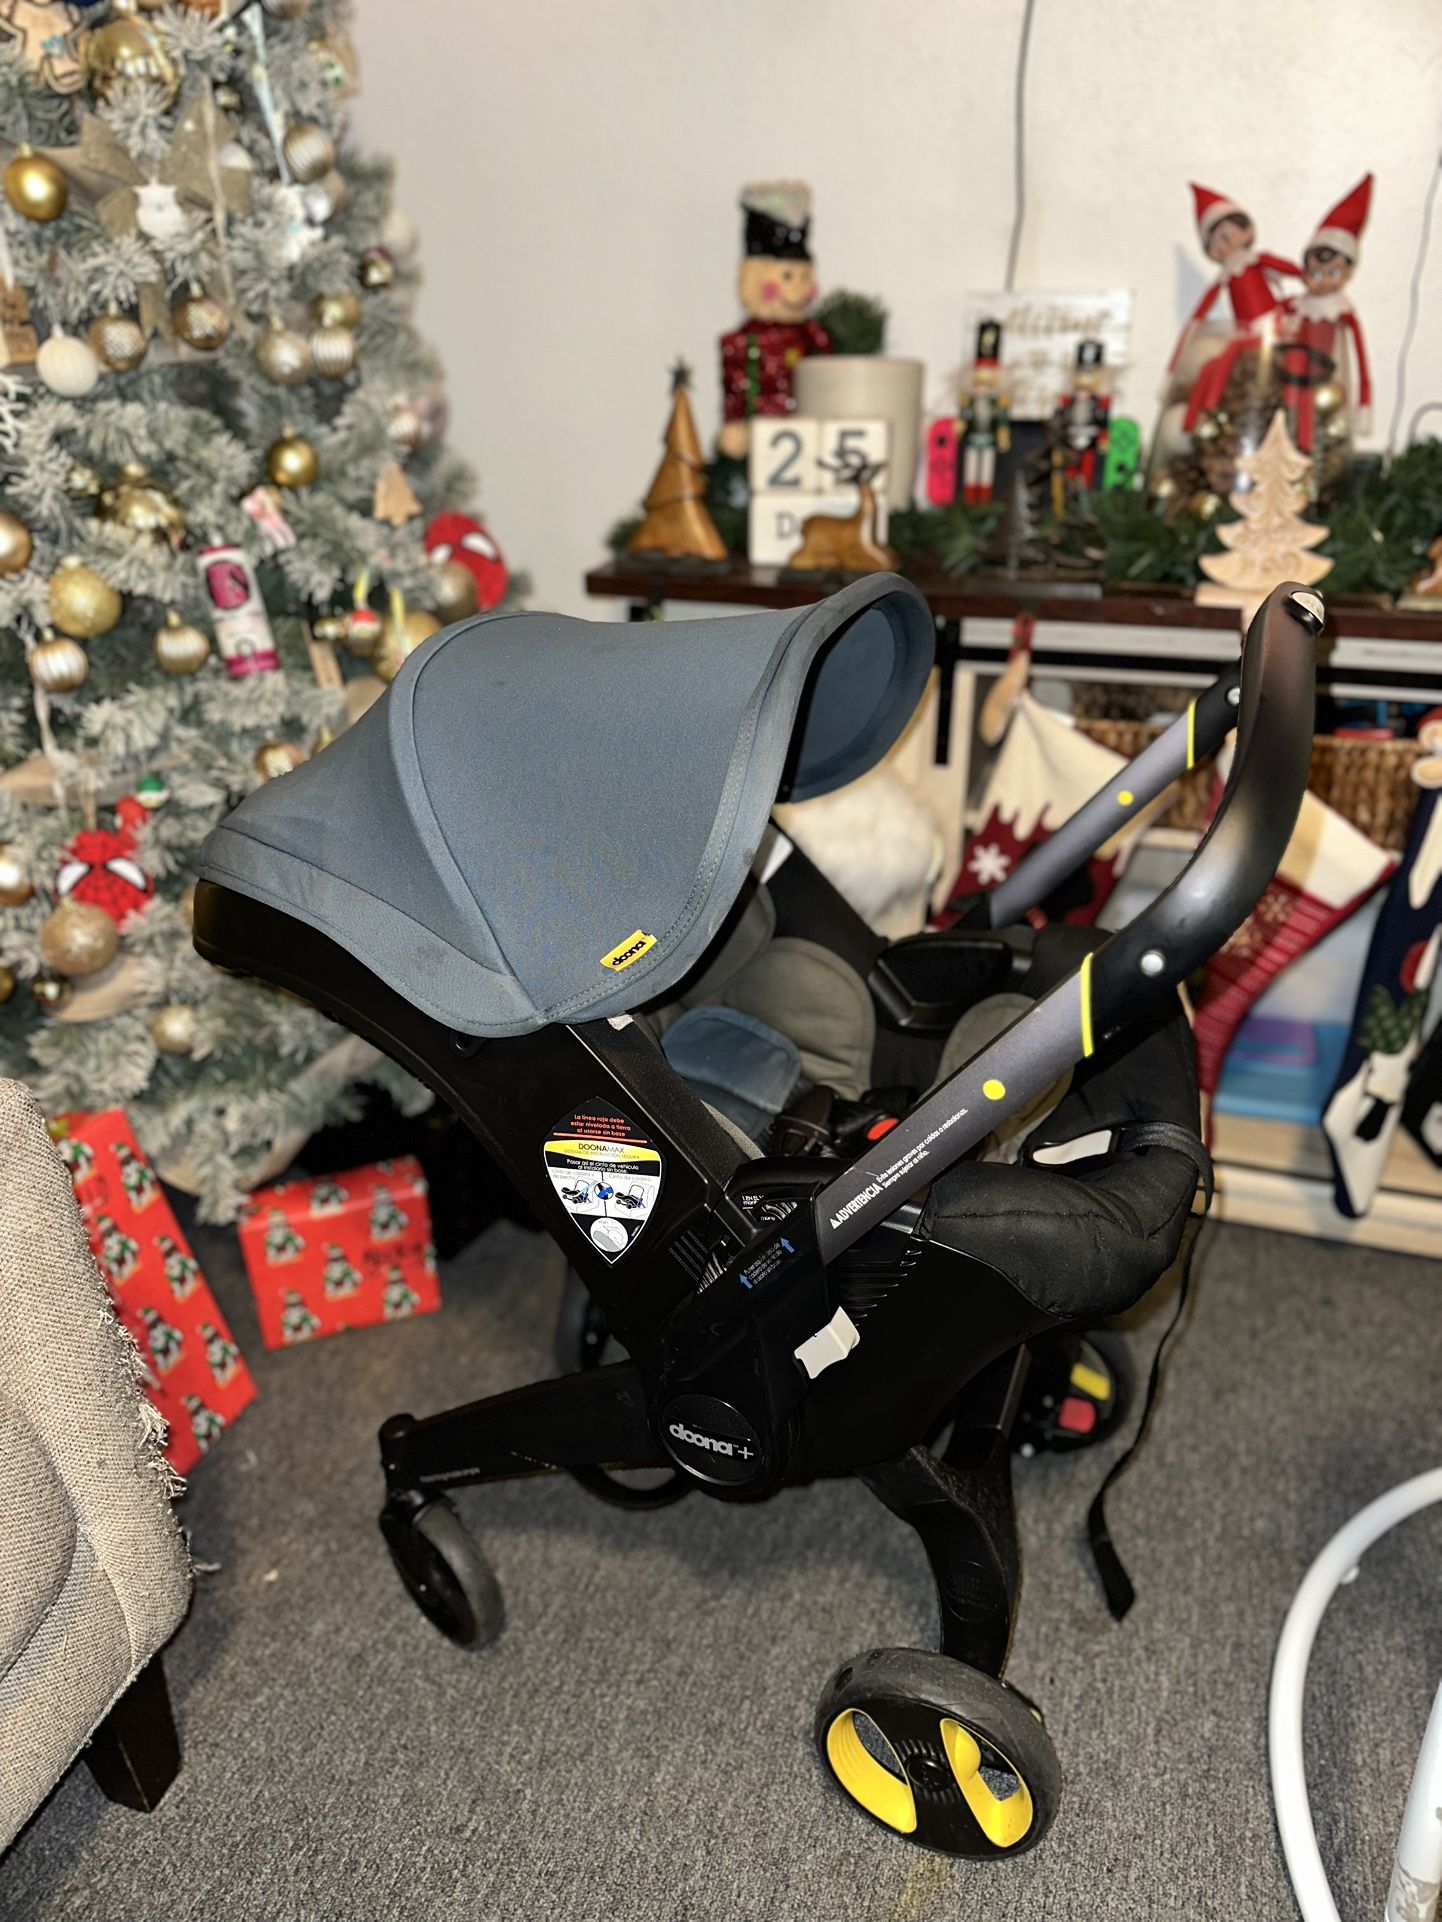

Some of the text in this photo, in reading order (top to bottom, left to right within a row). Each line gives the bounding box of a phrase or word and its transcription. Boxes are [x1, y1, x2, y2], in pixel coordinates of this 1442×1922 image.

[612, 940, 646, 965] doona
[578, 1143, 624, 1153] DOONAMAX
[903, 1148, 918, 1163] graves
[916, 1142, 925, 1151] por
[835, 1182, 884, 1223] ADVERTENCIA
